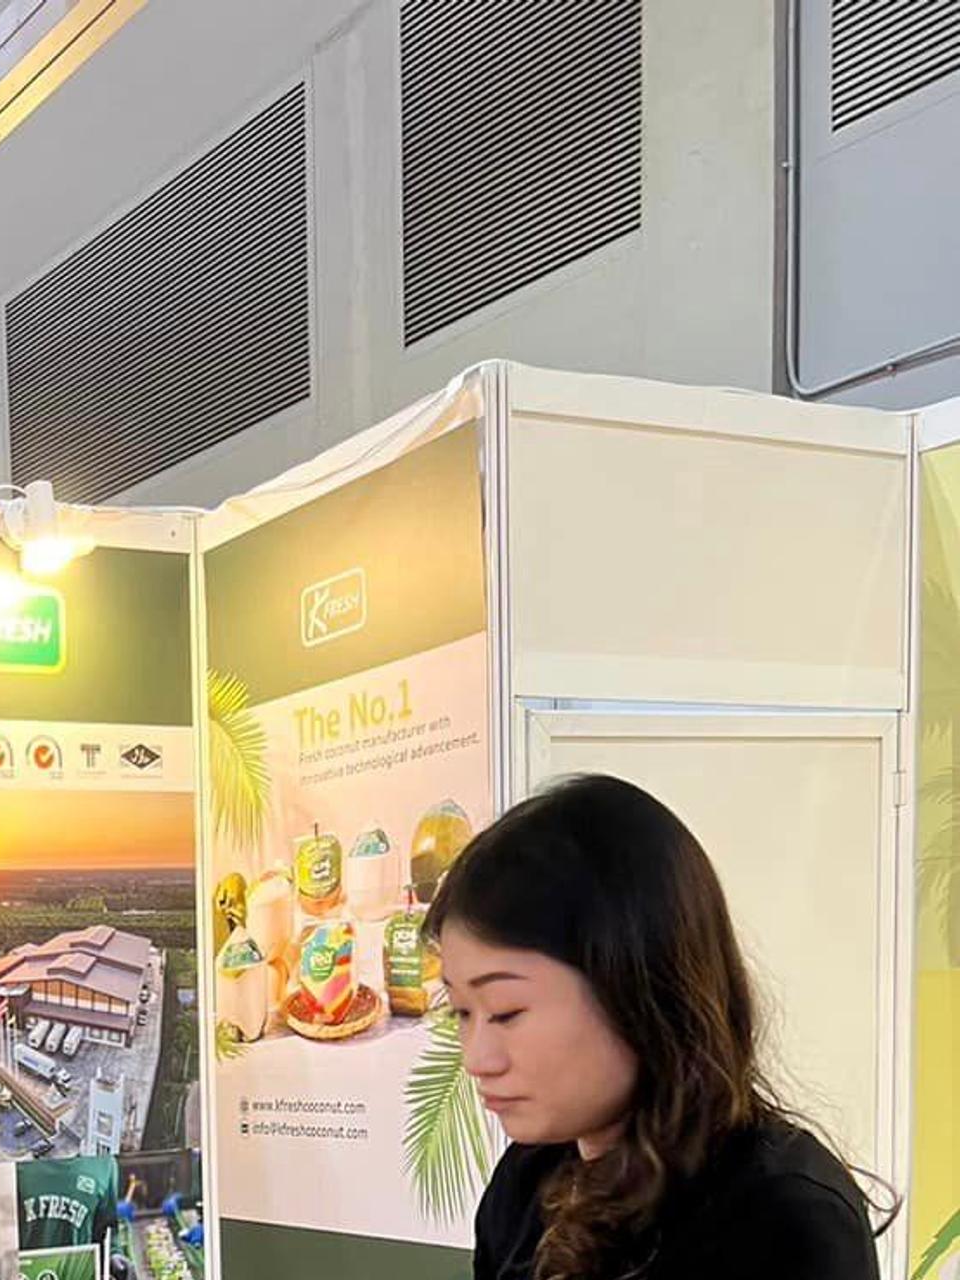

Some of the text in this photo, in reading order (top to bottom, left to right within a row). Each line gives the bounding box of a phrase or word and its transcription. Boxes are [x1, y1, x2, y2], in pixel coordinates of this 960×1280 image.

[292, 678, 413, 750] The No.1
[39, 1194, 89, 1229] FRESH
